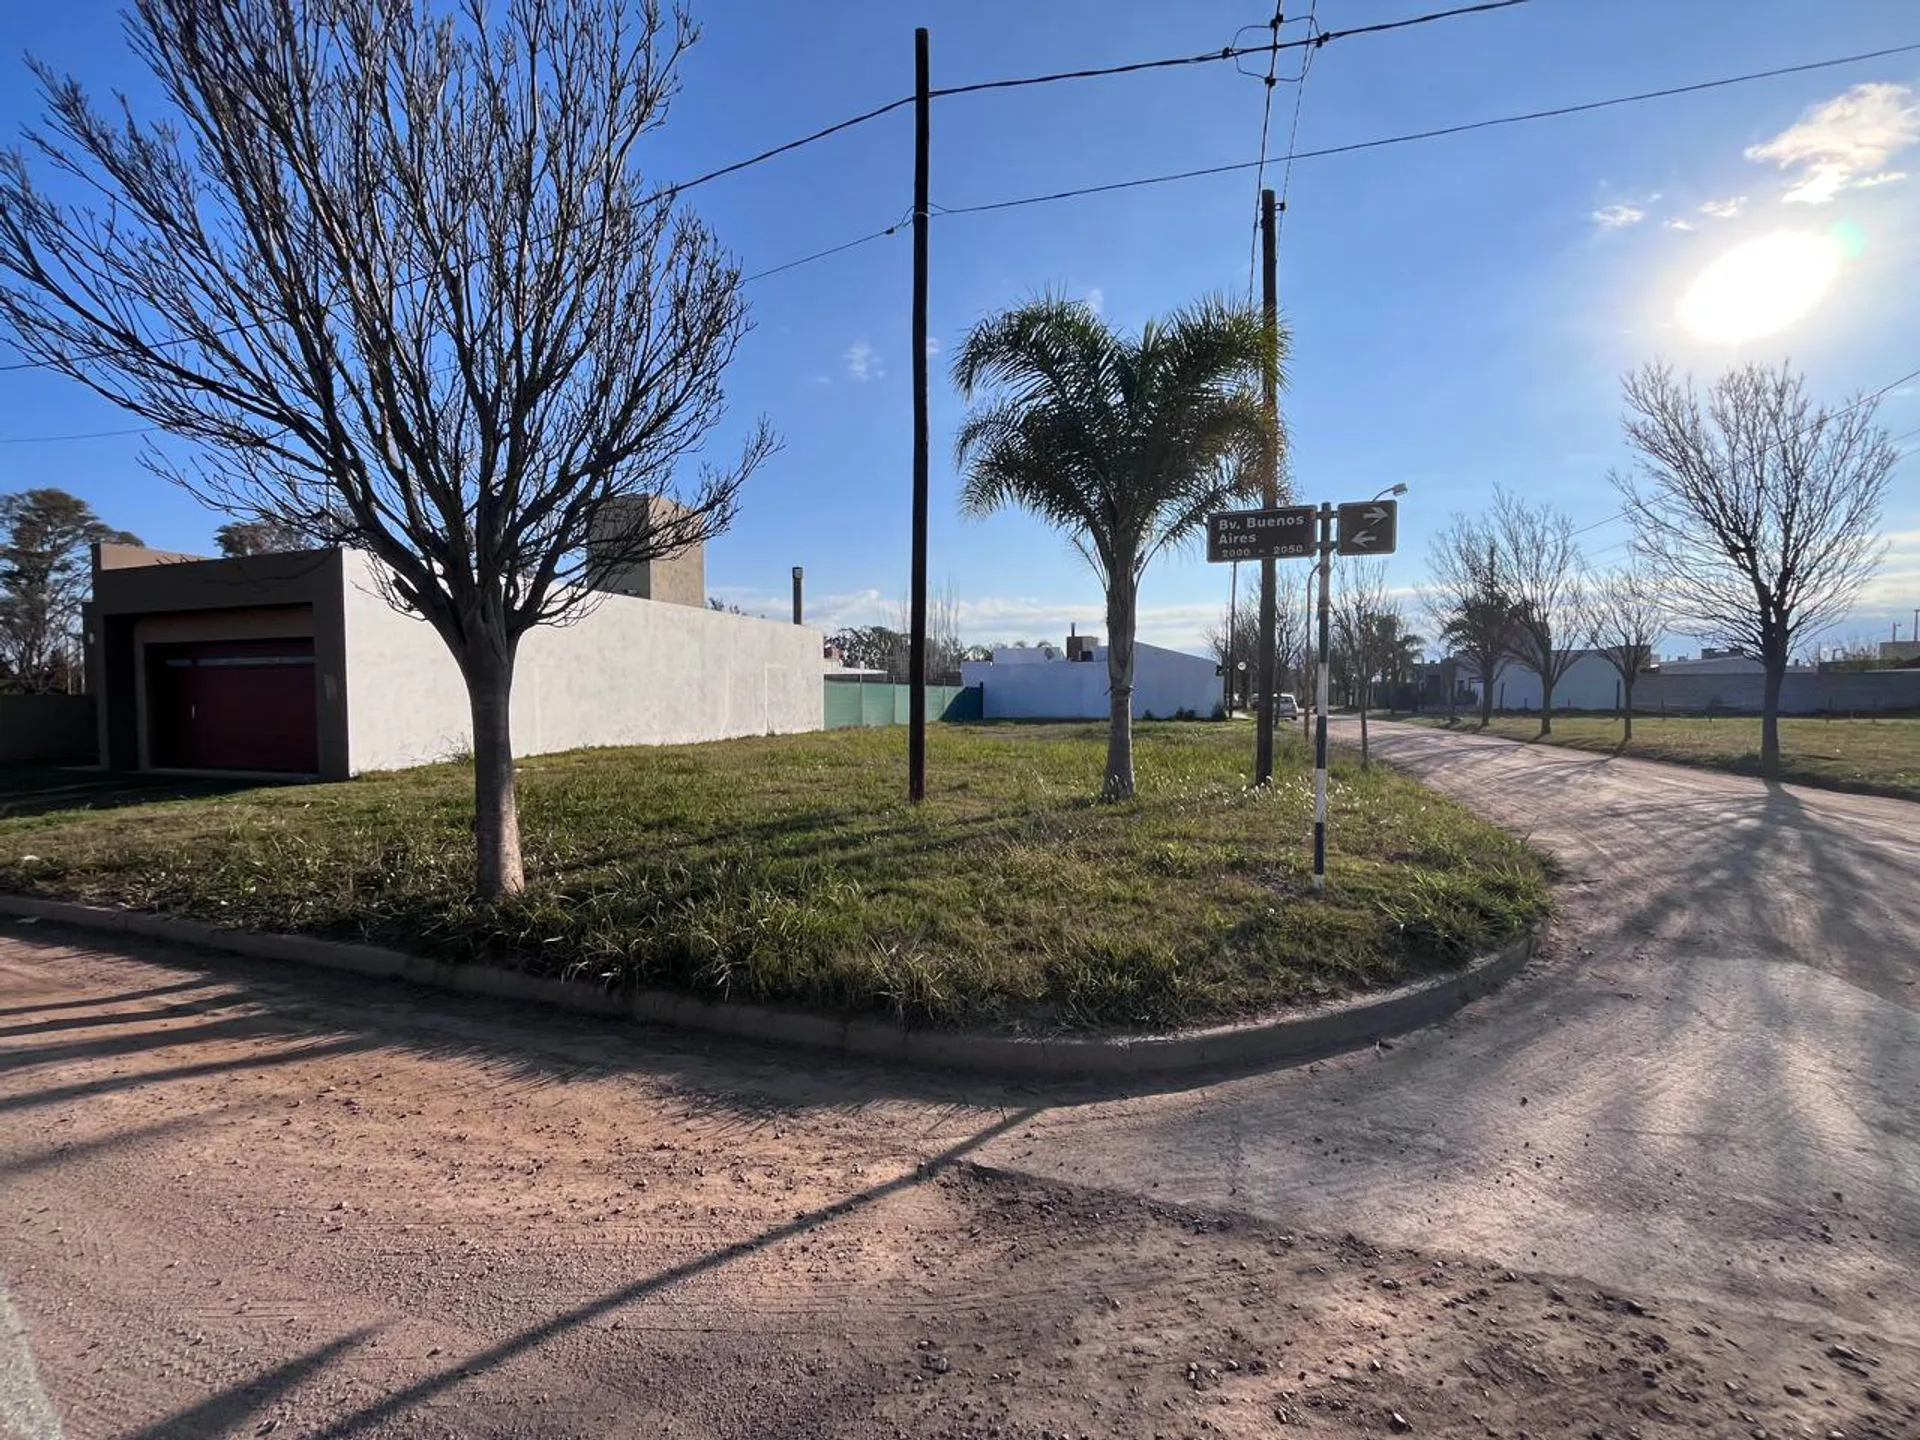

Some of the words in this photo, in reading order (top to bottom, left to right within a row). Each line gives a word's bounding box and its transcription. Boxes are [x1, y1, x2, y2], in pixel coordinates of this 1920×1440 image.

[1219, 519, 1240, 530] Bv.
[1246, 515, 1305, 528] Buenos
[1218, 533, 1257, 545] Aires
[1222, 548, 1251, 558] 2000
[1273, 544, 1304, 555] 2050
